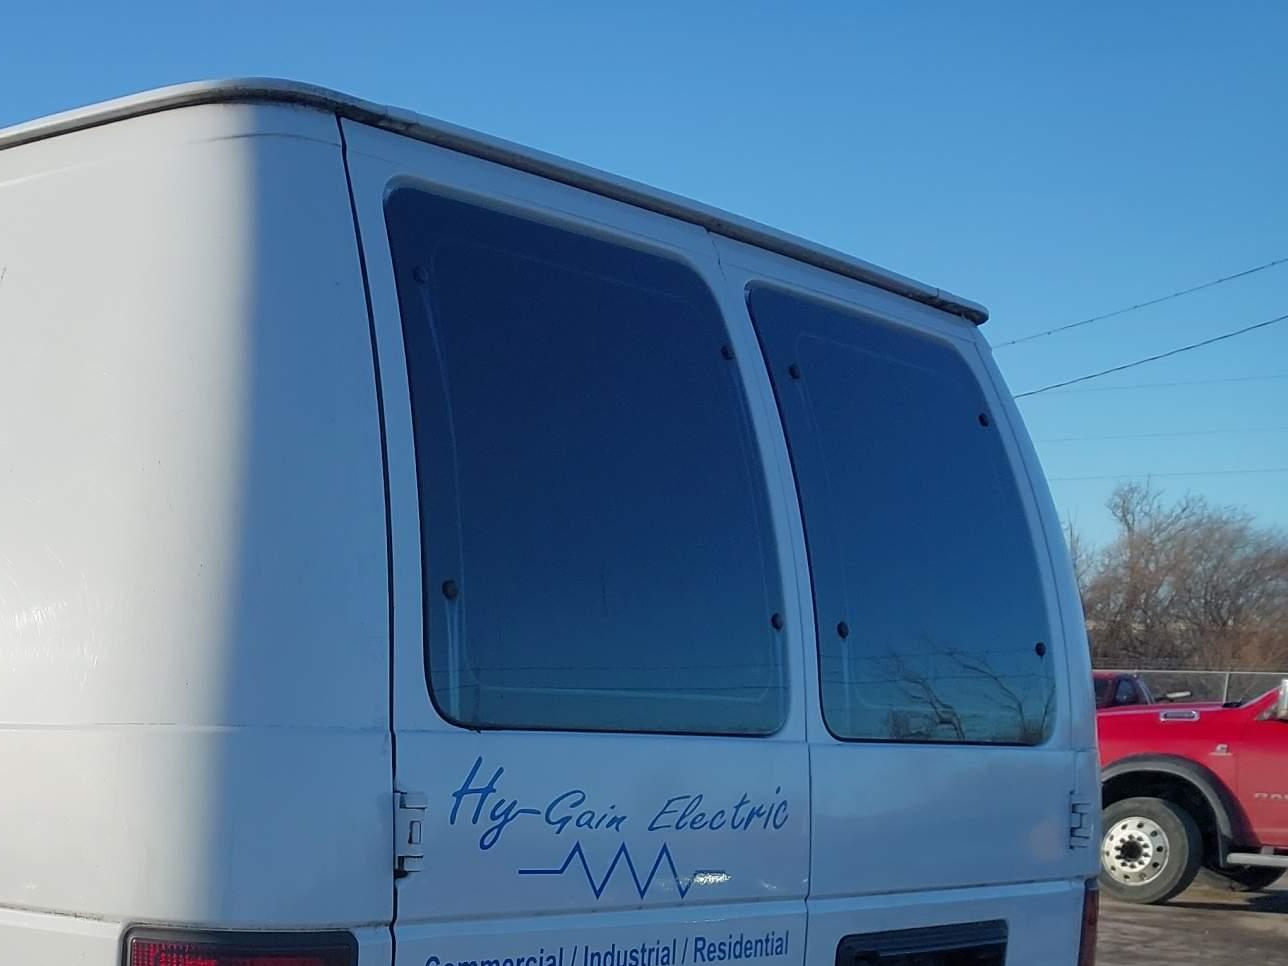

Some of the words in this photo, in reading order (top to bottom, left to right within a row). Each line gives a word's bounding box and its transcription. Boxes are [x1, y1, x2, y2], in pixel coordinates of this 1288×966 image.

[449, 755, 627, 850] Hy-Gain
[647, 785, 790, 832] Electric
[693, 930, 790, 963] Residential
